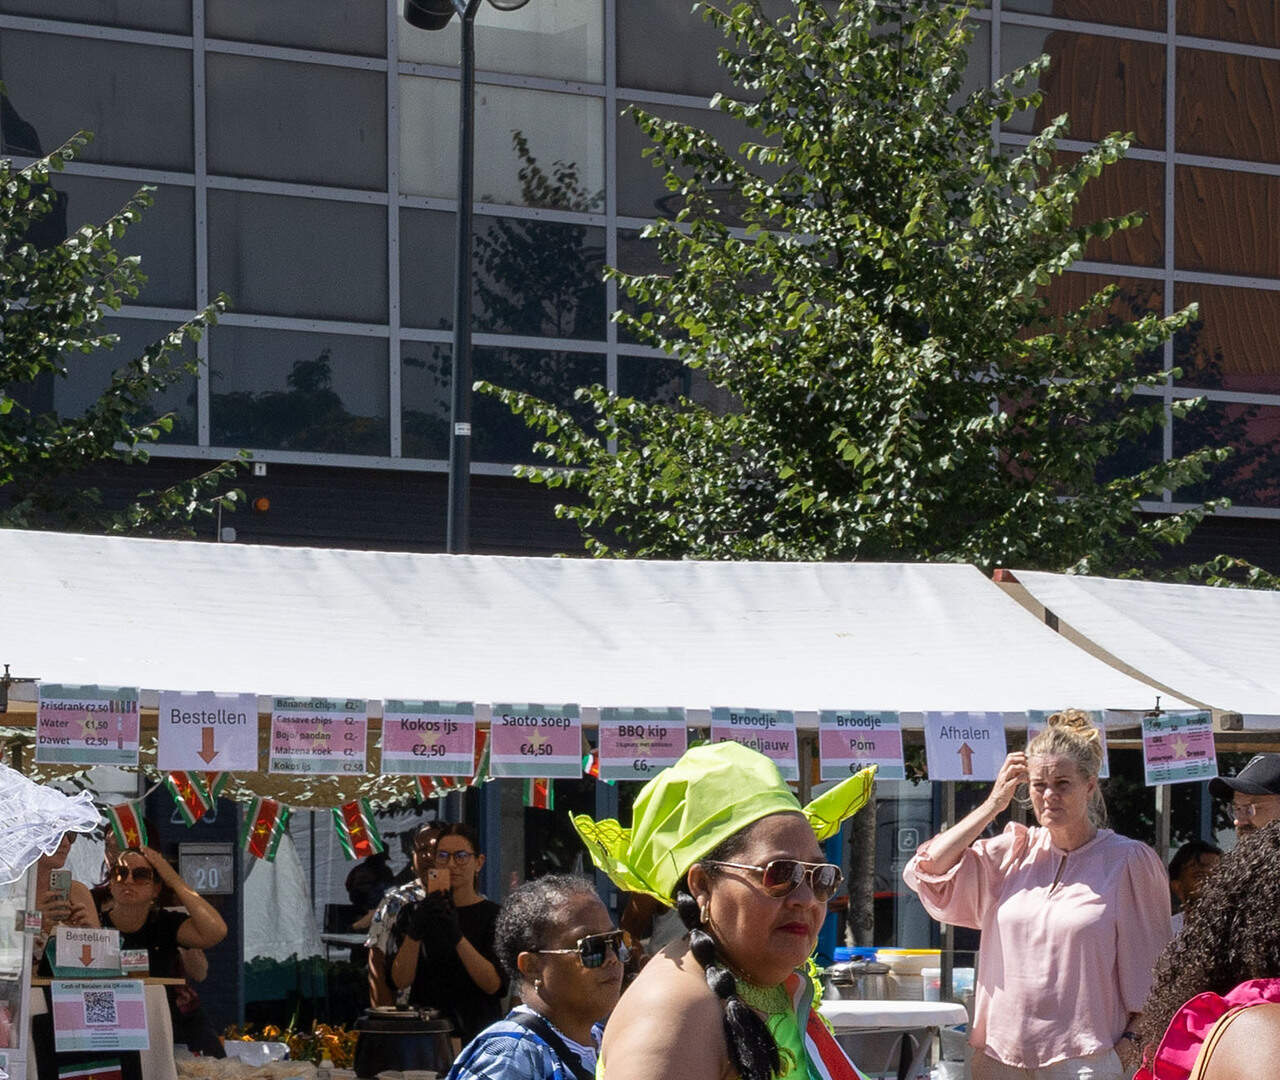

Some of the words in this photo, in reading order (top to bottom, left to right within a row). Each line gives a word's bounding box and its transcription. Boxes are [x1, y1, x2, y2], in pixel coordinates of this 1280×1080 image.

[41, 702, 85, 711] Frisdrank
[85, 704, 108, 713] €2,50
[277, 700, 313, 709] Bananen
[315, 701, 337, 711] chips
[171, 709, 247, 725] Bestellen
[276, 715, 309, 724] Cassave
[311, 716, 332, 726] chips
[502, 714, 538, 727] Saoto
[540, 717, 571, 731] soep
[730, 714, 777, 728] Broodje
[837, 715, 882, 730] Broodje
[41, 719, 69, 728] Water
[85, 720, 108, 730] €1,50
[400, 718, 441, 732] Kokos
[444, 719, 458, 735] ijs
[299, 732, 331, 741] pandan
[618, 725, 645, 739] BBQ
[648, 725, 667, 739] kip
[940, 726, 990, 740] Afhalen
[40, 735, 71, 745] Dawet
[85, 737, 108, 746] €2,50
[850, 739, 875, 751] Pom
[275, 746, 310, 755] Maizena
[312, 747, 332, 756] koek
[412, 744, 446, 758] €2,50
[520, 743, 553, 758] €4,50
[274, 762, 299, 770] Kokos
[633, 759, 655, 772] €6,-
[196, 868, 218, 889] 20
[66, 931, 111, 943] Bestellen
